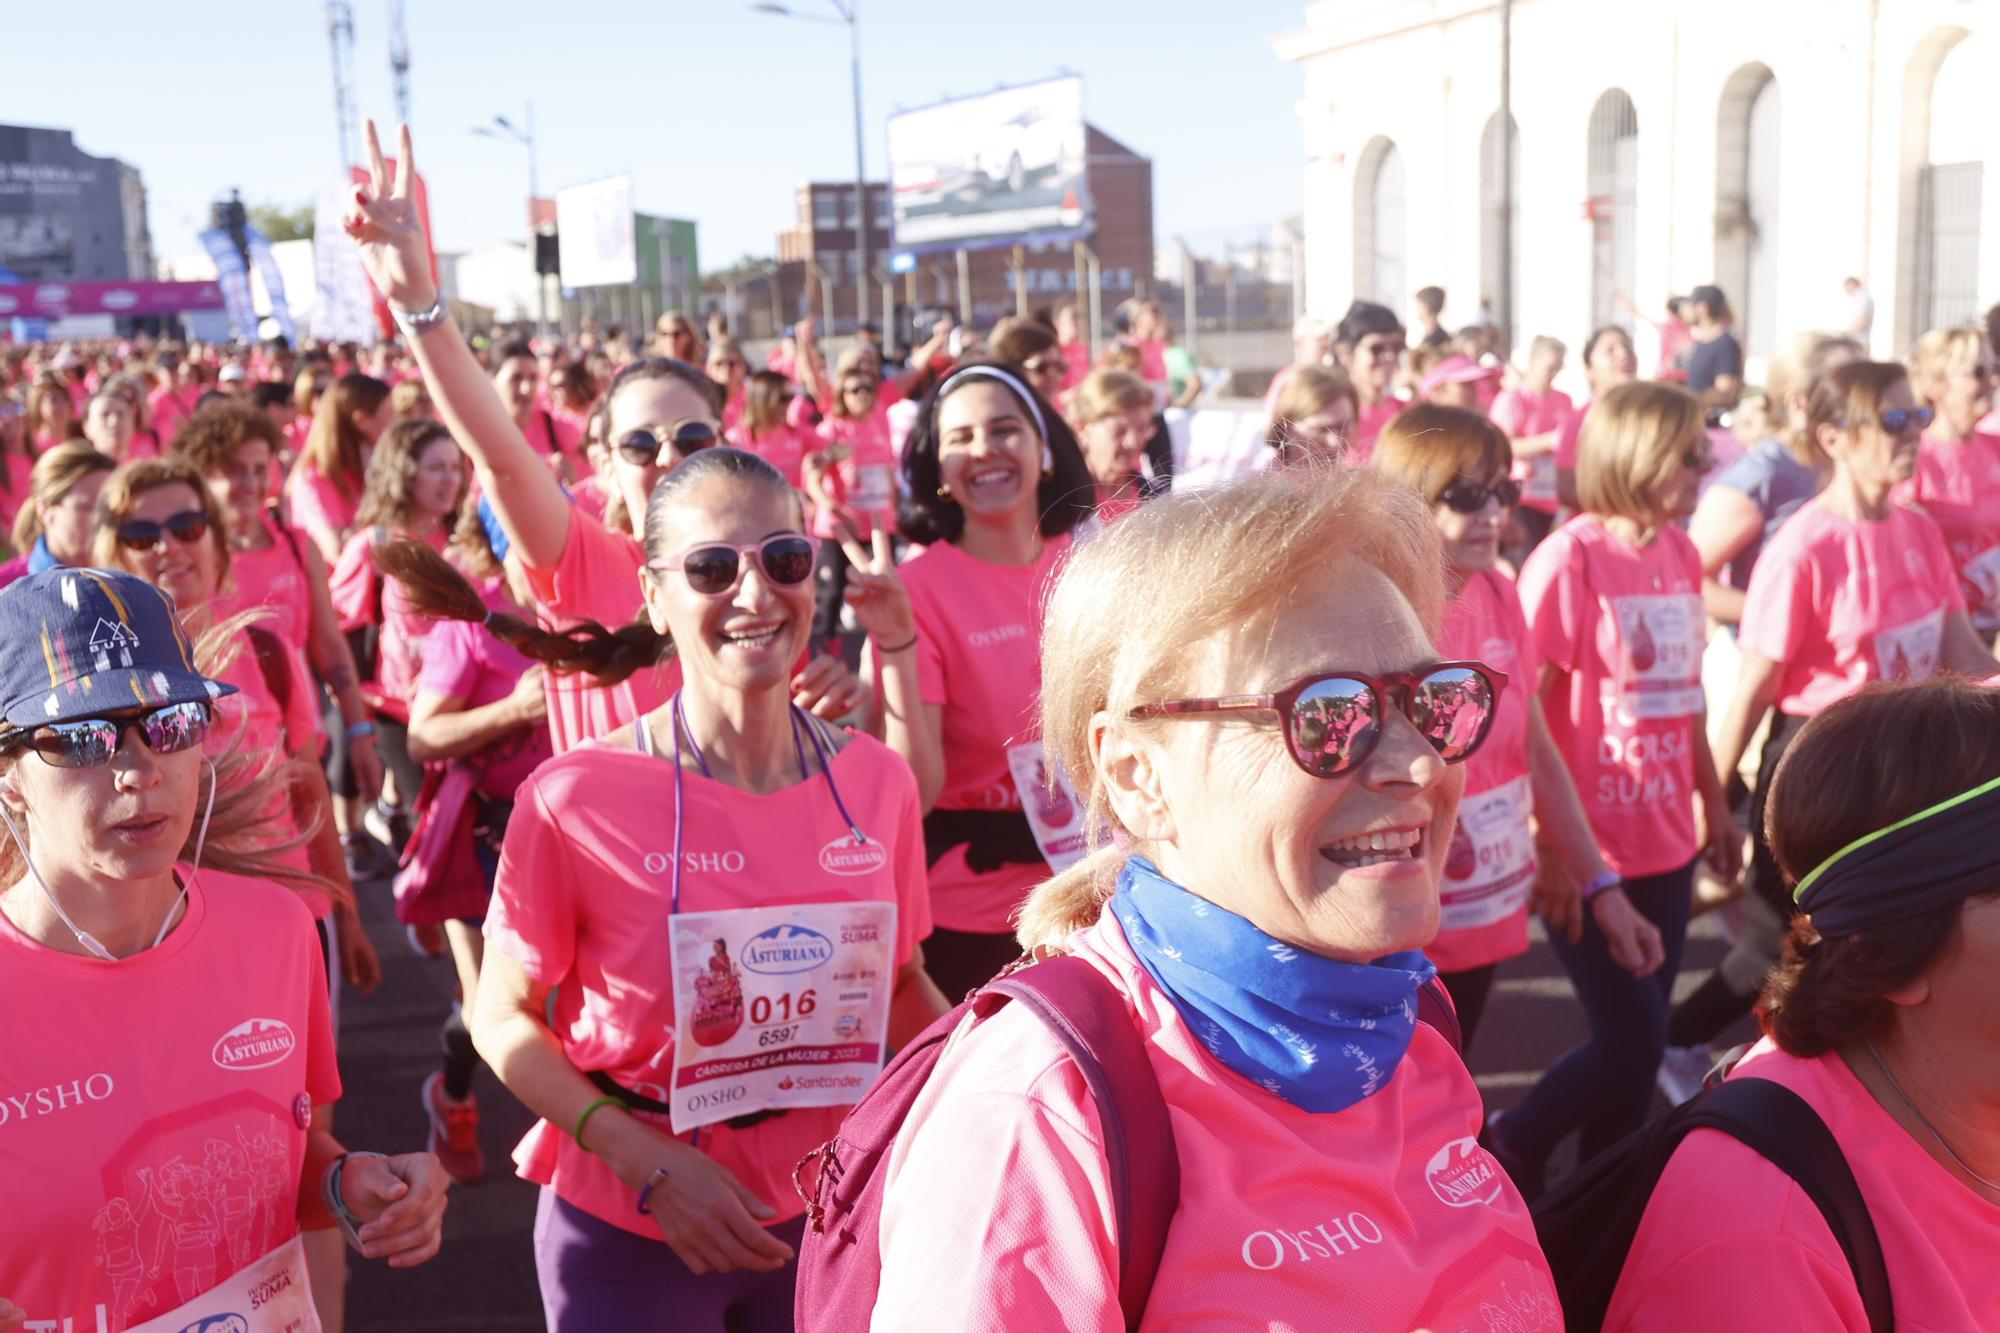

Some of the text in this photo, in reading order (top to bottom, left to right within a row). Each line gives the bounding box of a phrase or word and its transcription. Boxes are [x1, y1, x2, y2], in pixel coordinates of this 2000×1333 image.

[89, 640, 140, 653] BUFF
[841, 930, 878, 944] SUMA
[748, 944, 826, 965] ASTURIANA
[750, 988, 817, 1025] 016
[758, 1024, 800, 1047] 6597
[221, 1035, 291, 1064] ASTURIANA
[695, 1060, 750, 1080] CARRERA
[751, 1055, 768, 1067] DE
[769, 1053, 784, 1066] LA
[785, 1049, 830, 1062] MUJER
[795, 1075, 864, 1090] Santander
[687, 1085, 746, 1112] OYSHO
[1241, 1211, 1383, 1271] OYSHO
[251, 1275, 292, 1310] SUMA
